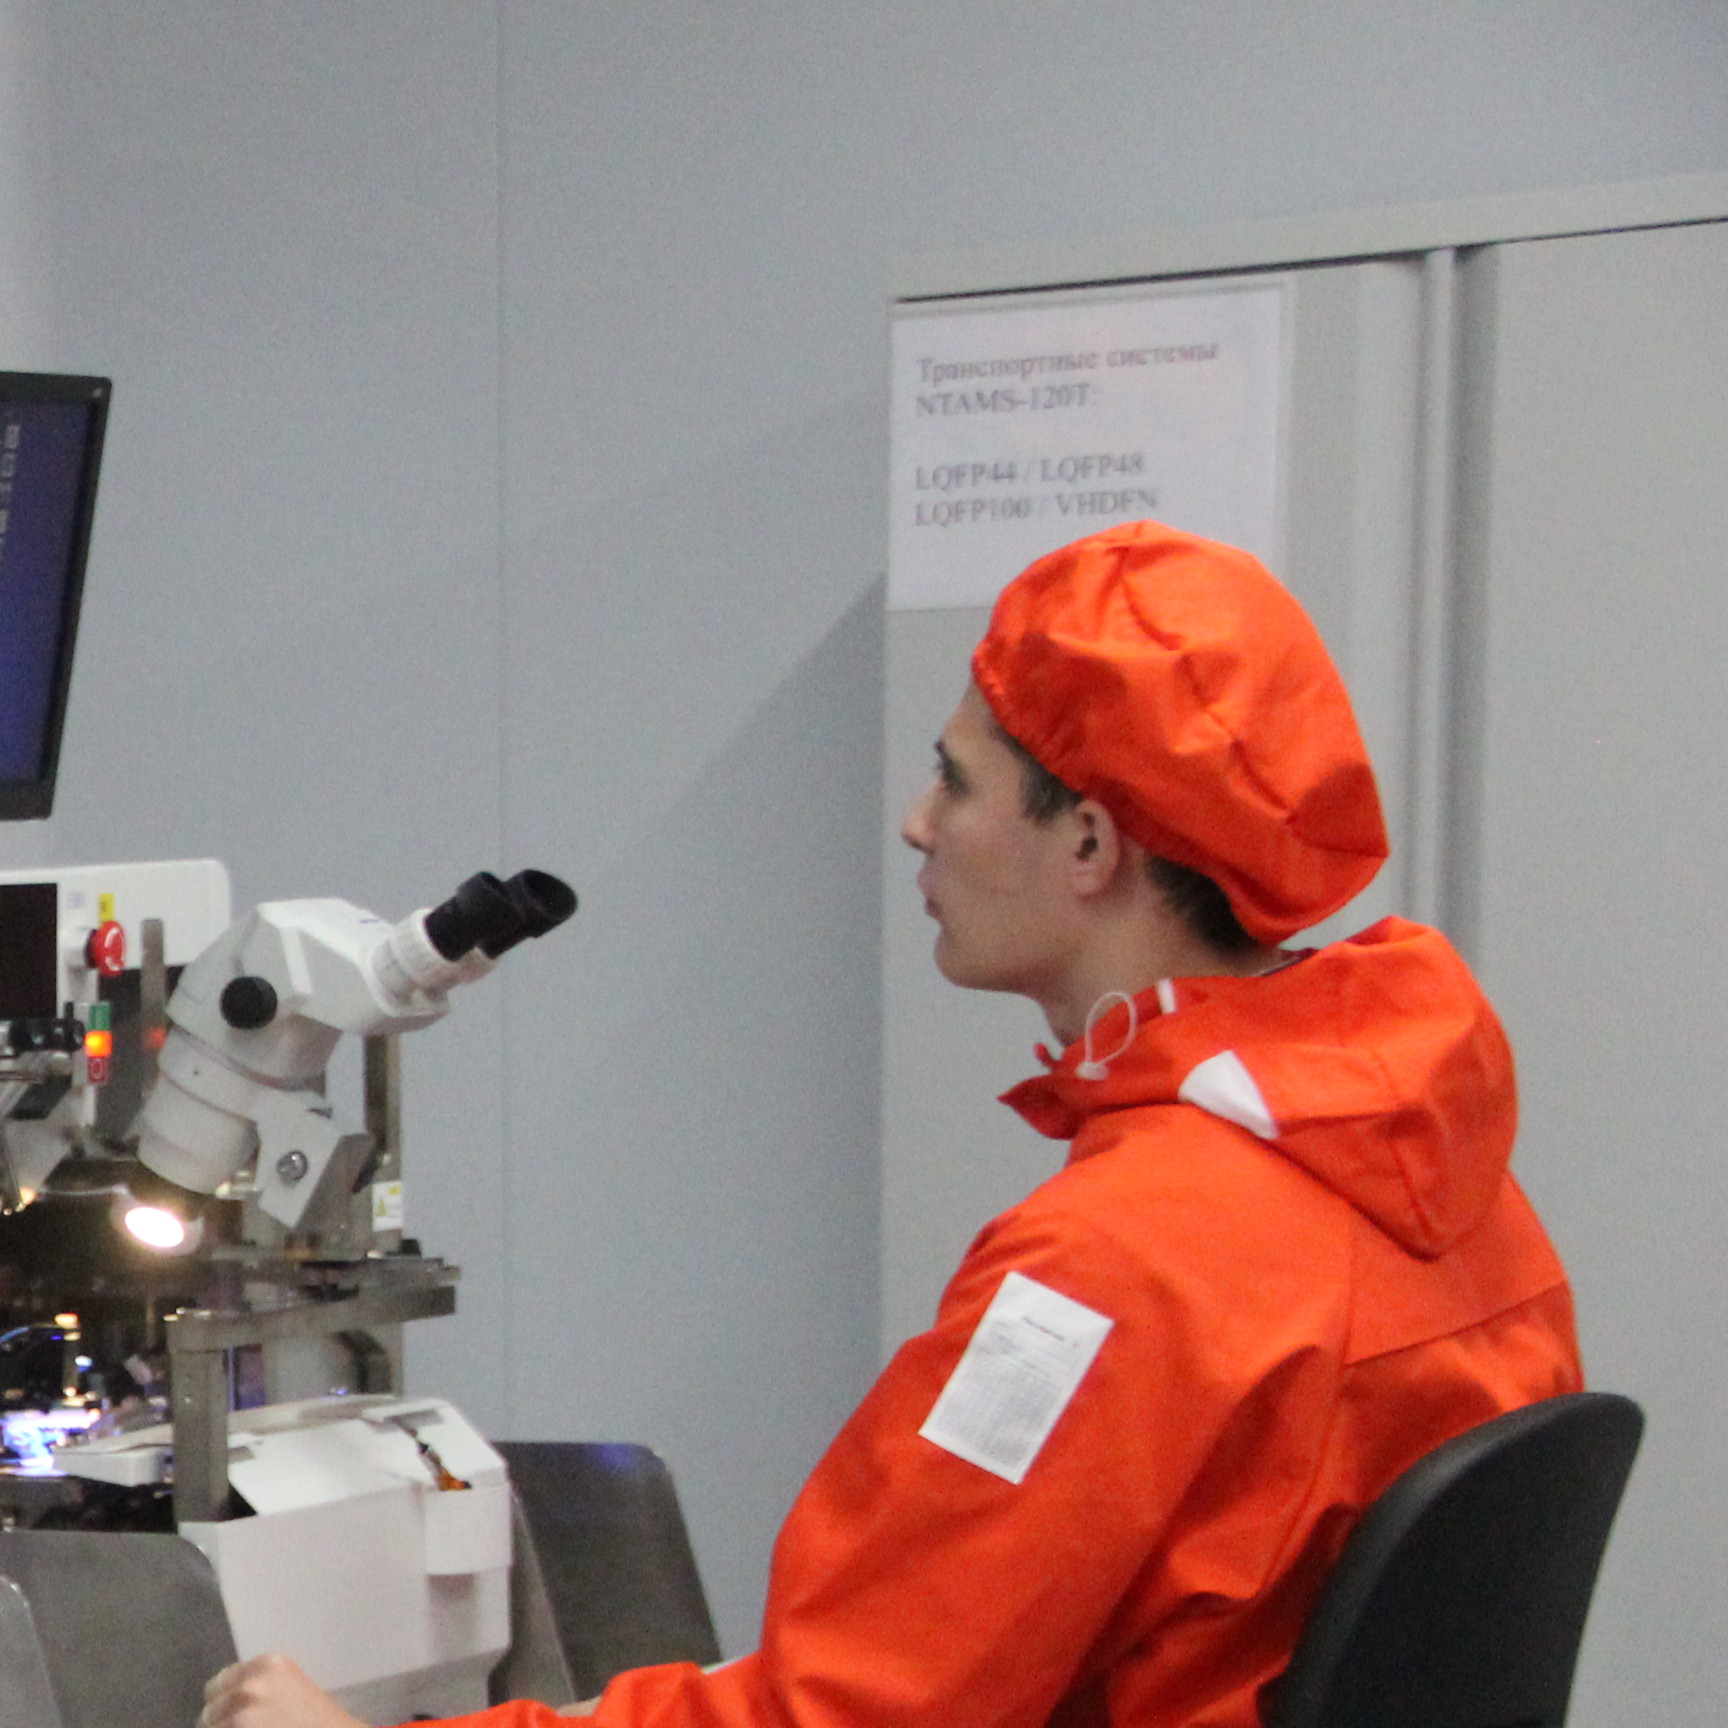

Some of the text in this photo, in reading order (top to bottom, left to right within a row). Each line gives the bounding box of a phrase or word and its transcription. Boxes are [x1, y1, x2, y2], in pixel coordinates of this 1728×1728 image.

[916, 343, 1219, 386] Транспортные системы
[915, 460, 1018, 493] LQFP44
[1039, 452, 1147, 485] LQFP48
[914, 496, 1033, 528] LQFP100
